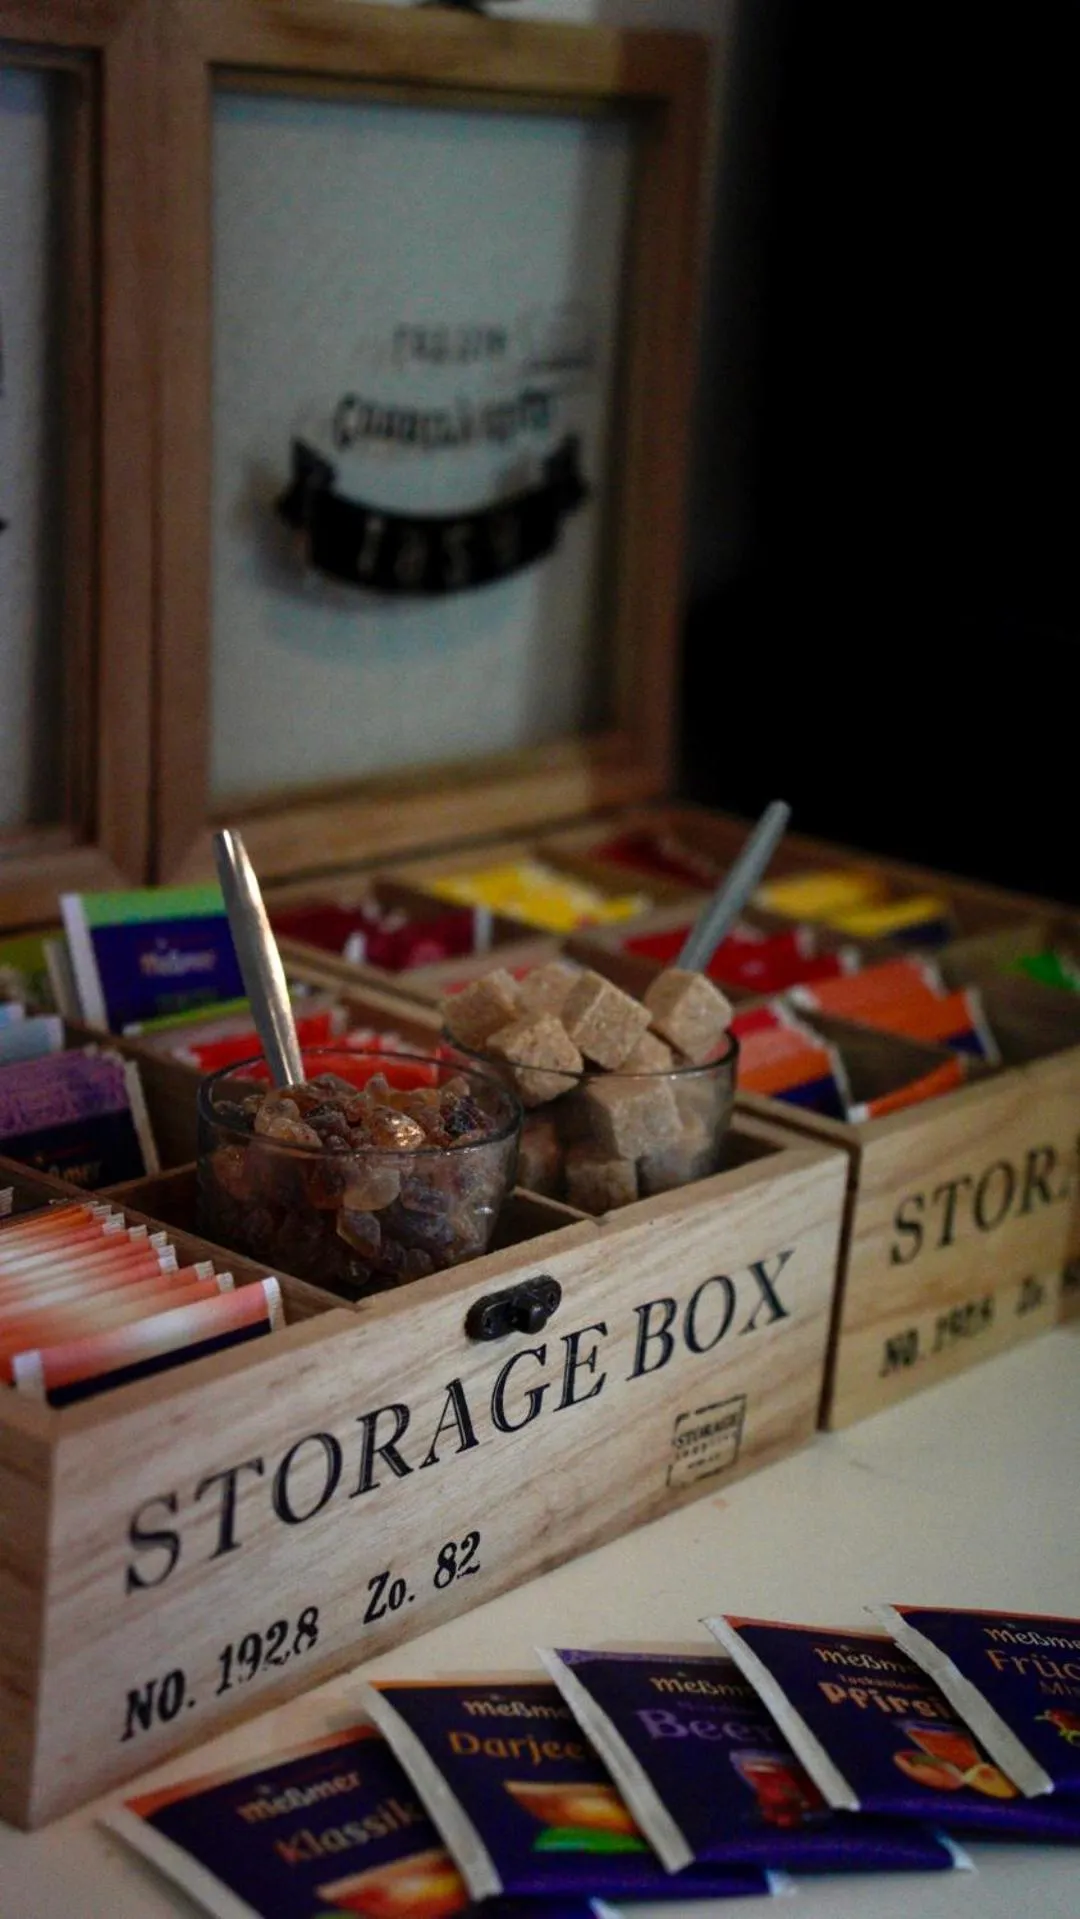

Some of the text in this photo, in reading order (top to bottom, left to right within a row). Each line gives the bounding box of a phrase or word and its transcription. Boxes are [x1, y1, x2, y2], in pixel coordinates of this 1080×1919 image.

[126, 1249, 796, 1594] STORAGE BOX
[120, 1531, 481, 1742] NO. 1928 Zo. 82
[274, 1799, 425, 1865] Klassik
